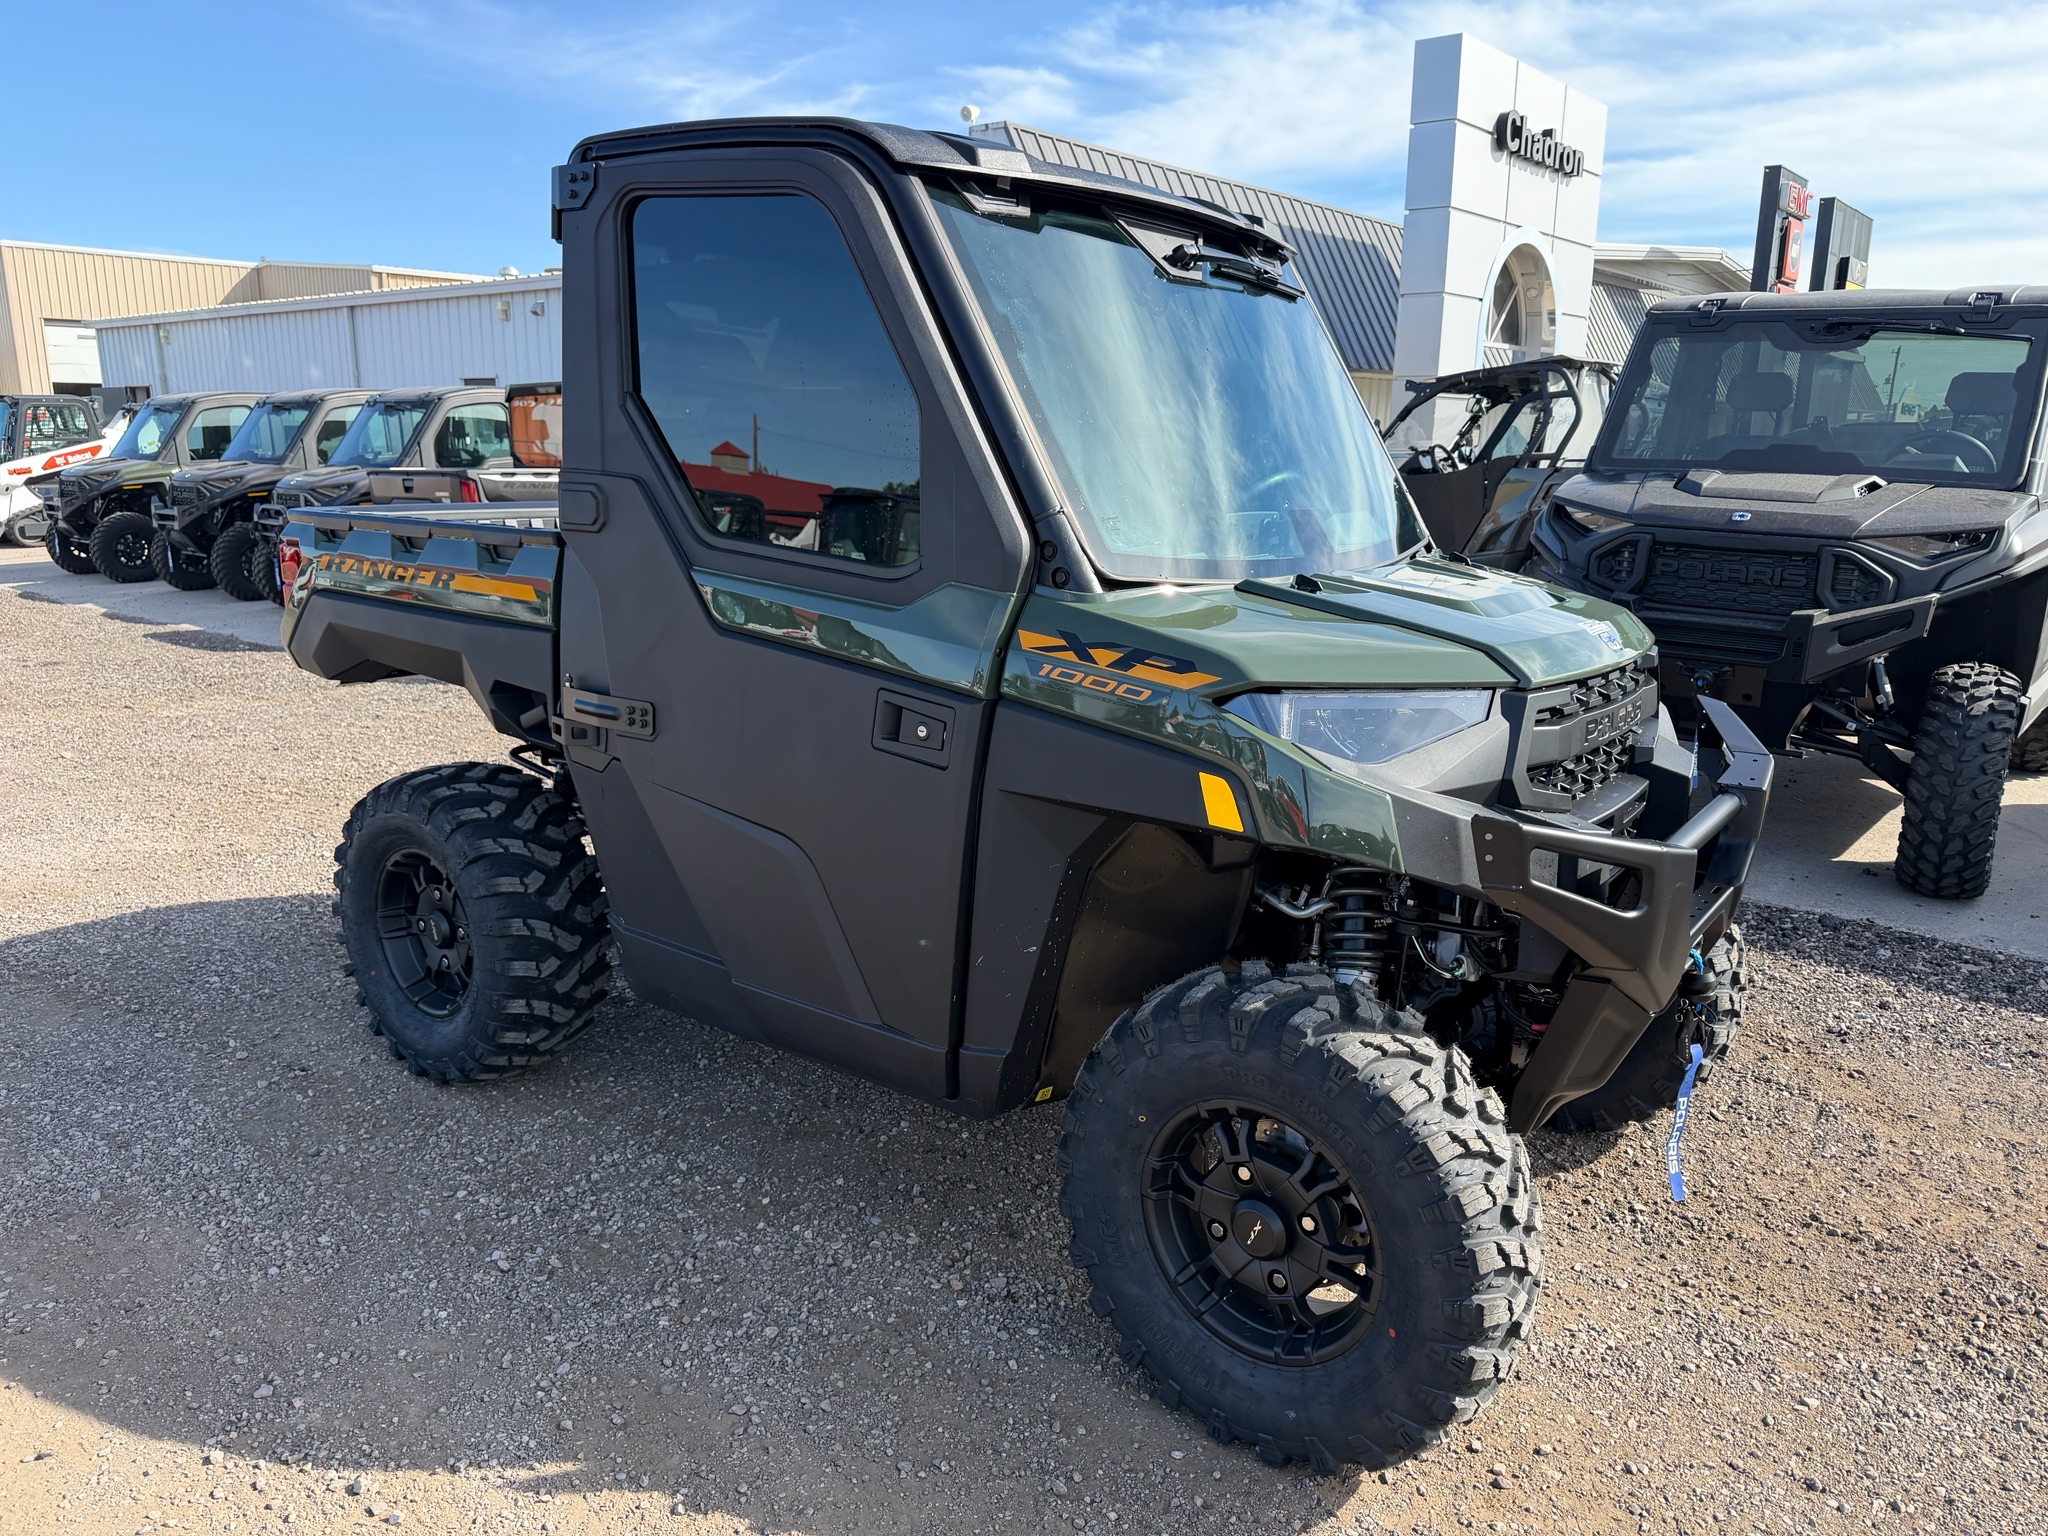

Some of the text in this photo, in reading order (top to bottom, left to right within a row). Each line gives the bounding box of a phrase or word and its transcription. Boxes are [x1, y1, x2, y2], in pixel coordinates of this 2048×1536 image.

[1498, 109, 1584, 178] Chadron
[1788, 181, 1814, 219] GMC
[67, 451, 93, 464] Bobcat
[319, 554, 456, 589] RANGER
[1655, 557, 1807, 588] POLARIS
[1029, 628, 1199, 675] XP
[1037, 663, 1153, 701] 1000
[1584, 699, 1642, 746] POLARIS
[1223, 1066, 1358, 1156] PRO ARMOR
[1668, 1096, 1688, 1175] POLARIS
[1246, 1219, 1263, 1245] XP
